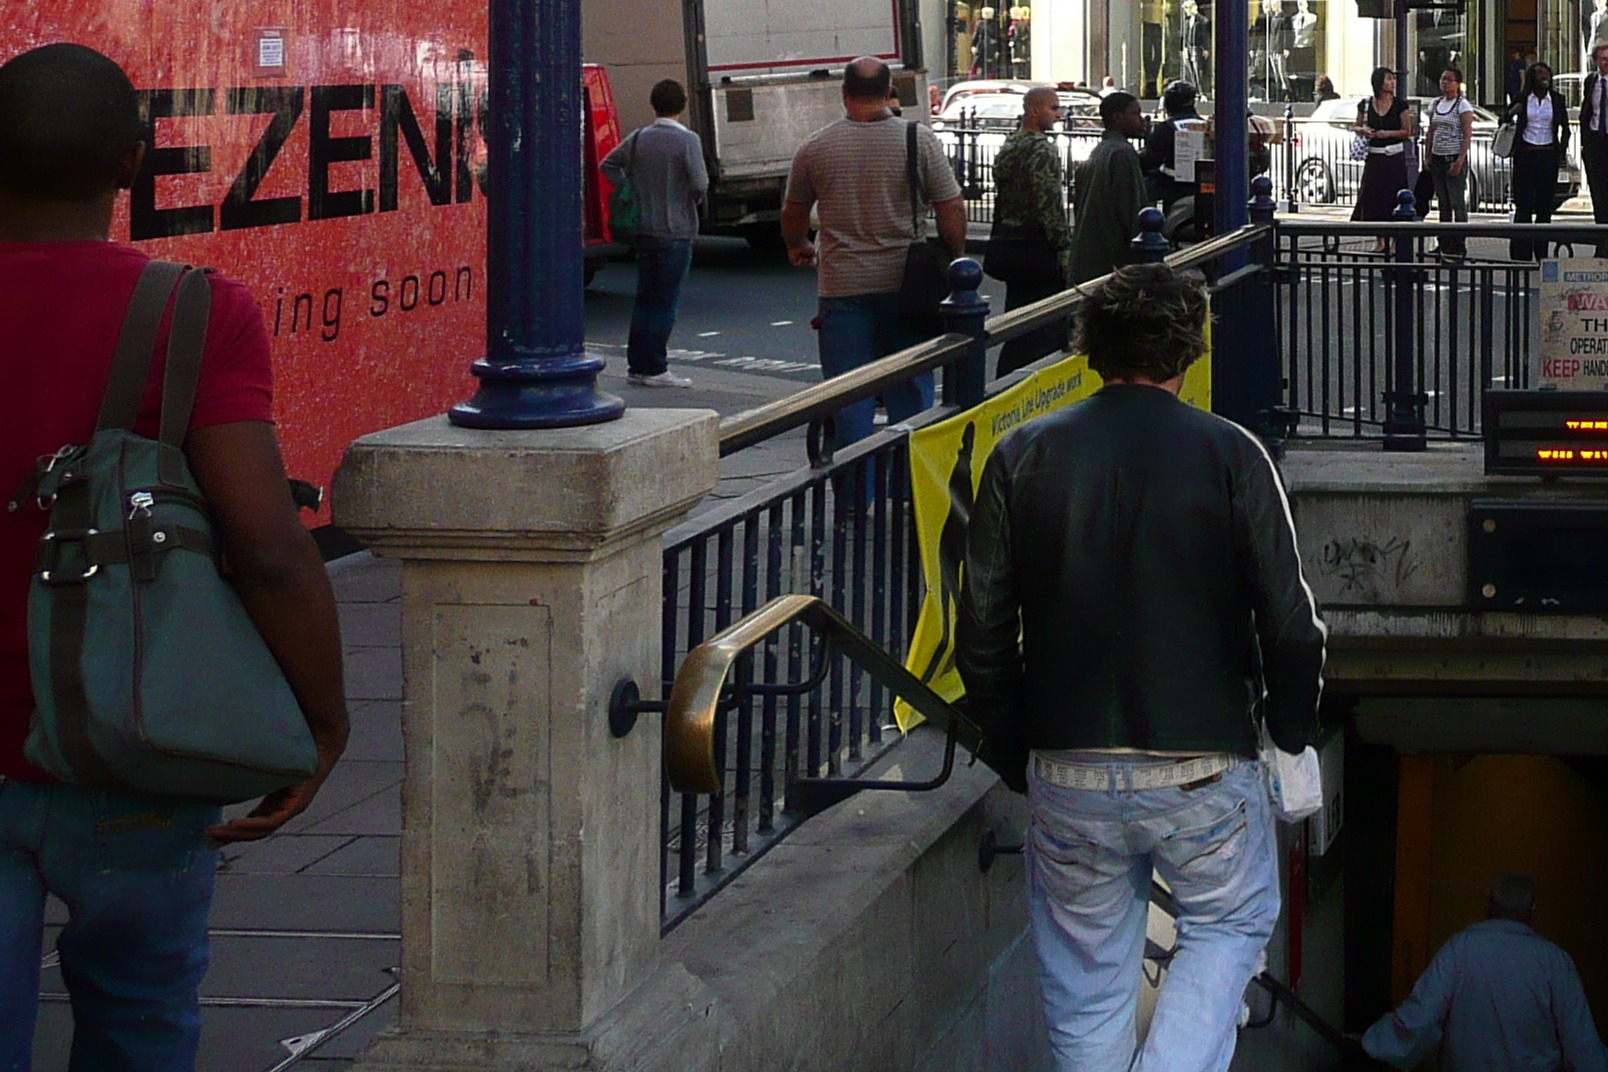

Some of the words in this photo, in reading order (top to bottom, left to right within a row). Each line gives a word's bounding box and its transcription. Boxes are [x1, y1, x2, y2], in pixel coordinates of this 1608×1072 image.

[130, 81, 487, 242] EZENI
[273, 286, 343, 343] ing
[369, 265, 472, 318] soon
[1543, 359, 1580, 378] KEEP
